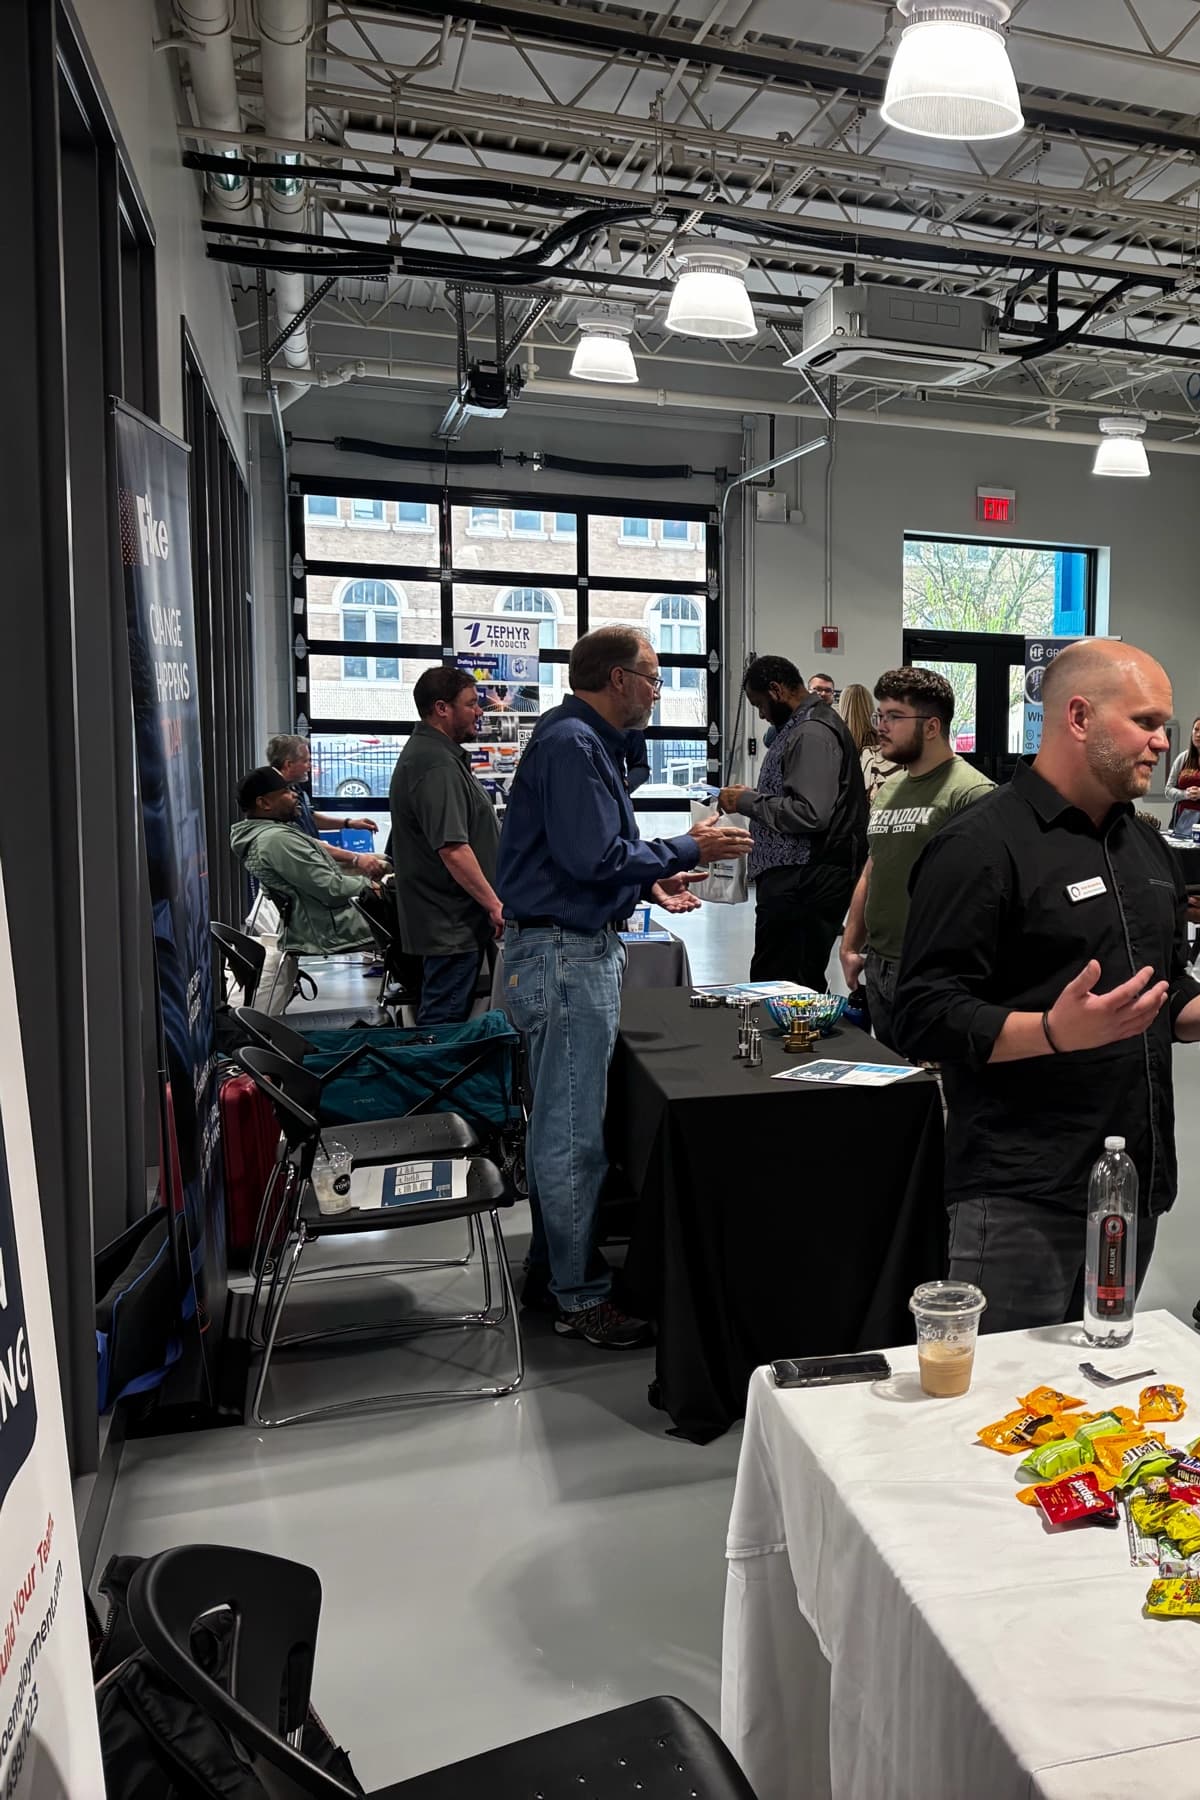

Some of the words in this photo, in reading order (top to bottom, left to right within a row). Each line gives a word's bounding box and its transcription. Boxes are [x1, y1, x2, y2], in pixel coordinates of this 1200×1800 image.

[984, 499, 1009, 520] EXIT
[136, 494, 169, 566] Fike
[486, 624, 530, 641] ZEPHYR
[490, 640, 527, 649] PRODUCTS
[13, 1562, 36, 1626] Your
